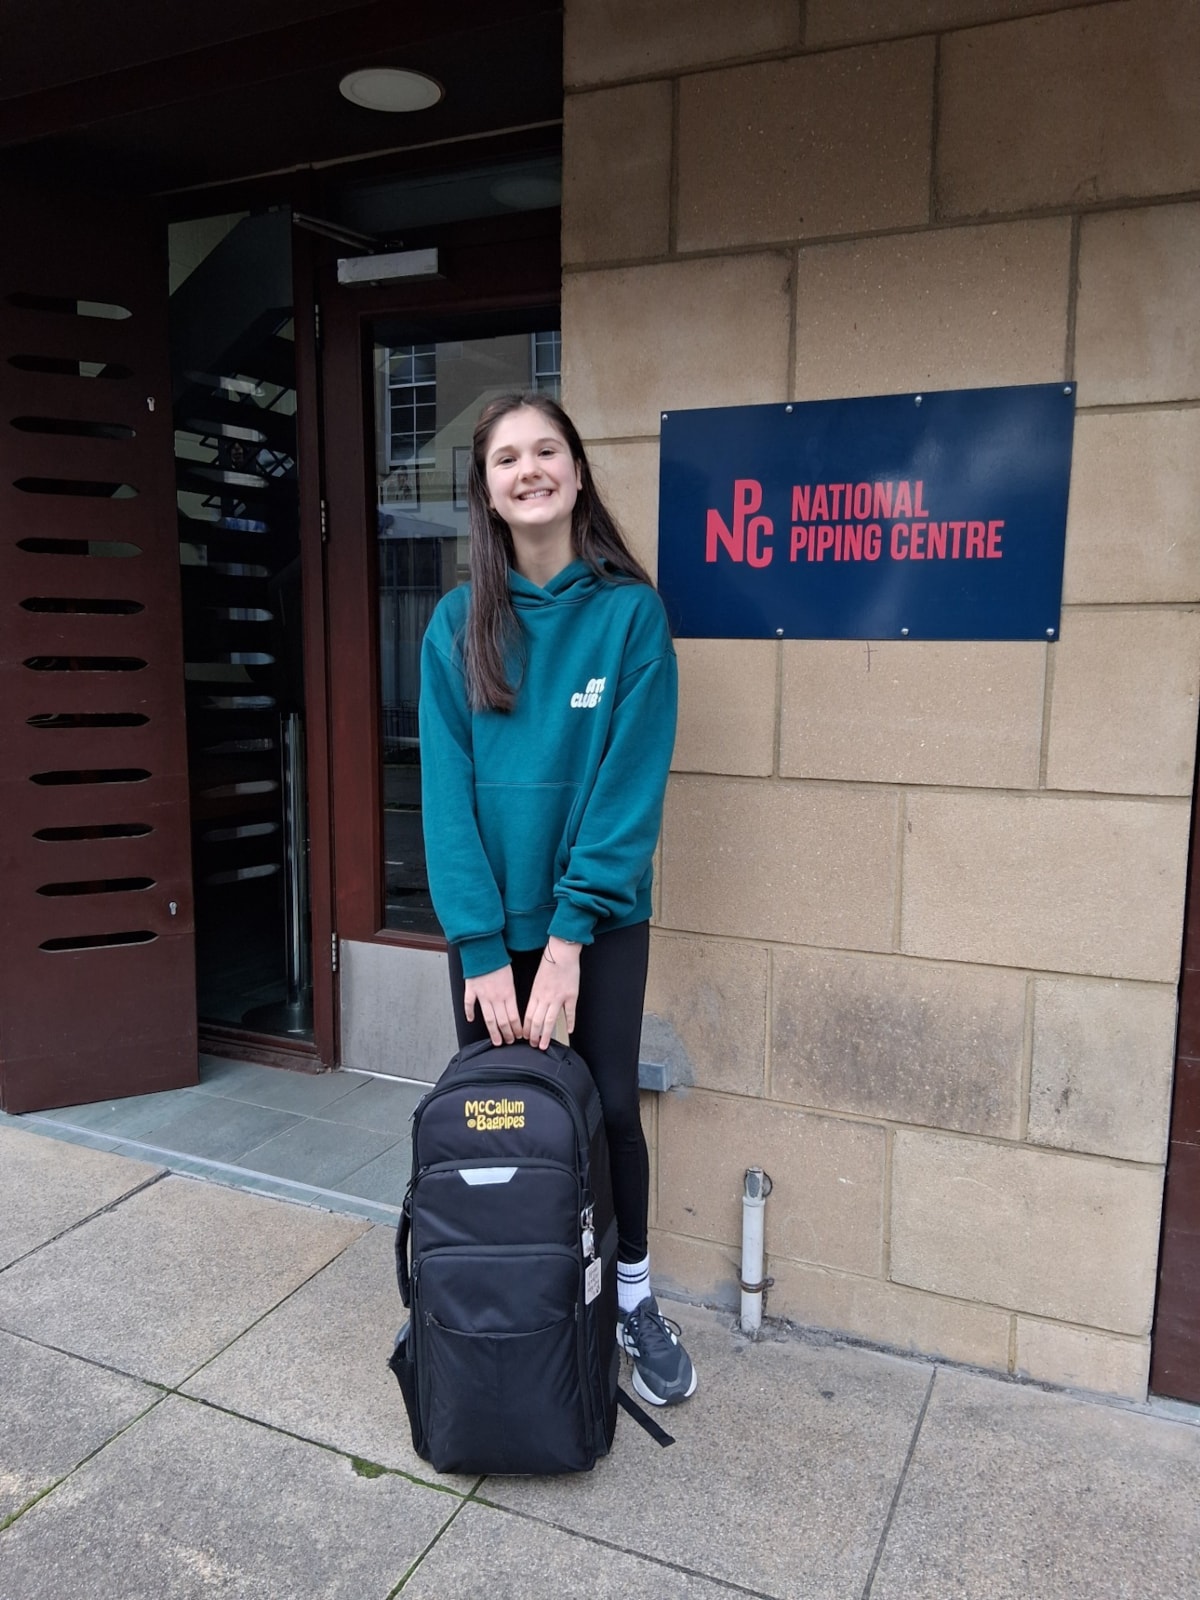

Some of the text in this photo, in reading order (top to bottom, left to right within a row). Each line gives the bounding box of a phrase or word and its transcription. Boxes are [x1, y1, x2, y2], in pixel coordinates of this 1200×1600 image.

[792, 480, 929, 521] NATIONAL
[790, 520, 1005, 562] PIPING CENTRE
[464, 1098, 525, 1117] McCallum
[476, 1114, 525, 1131] Bagpipes
